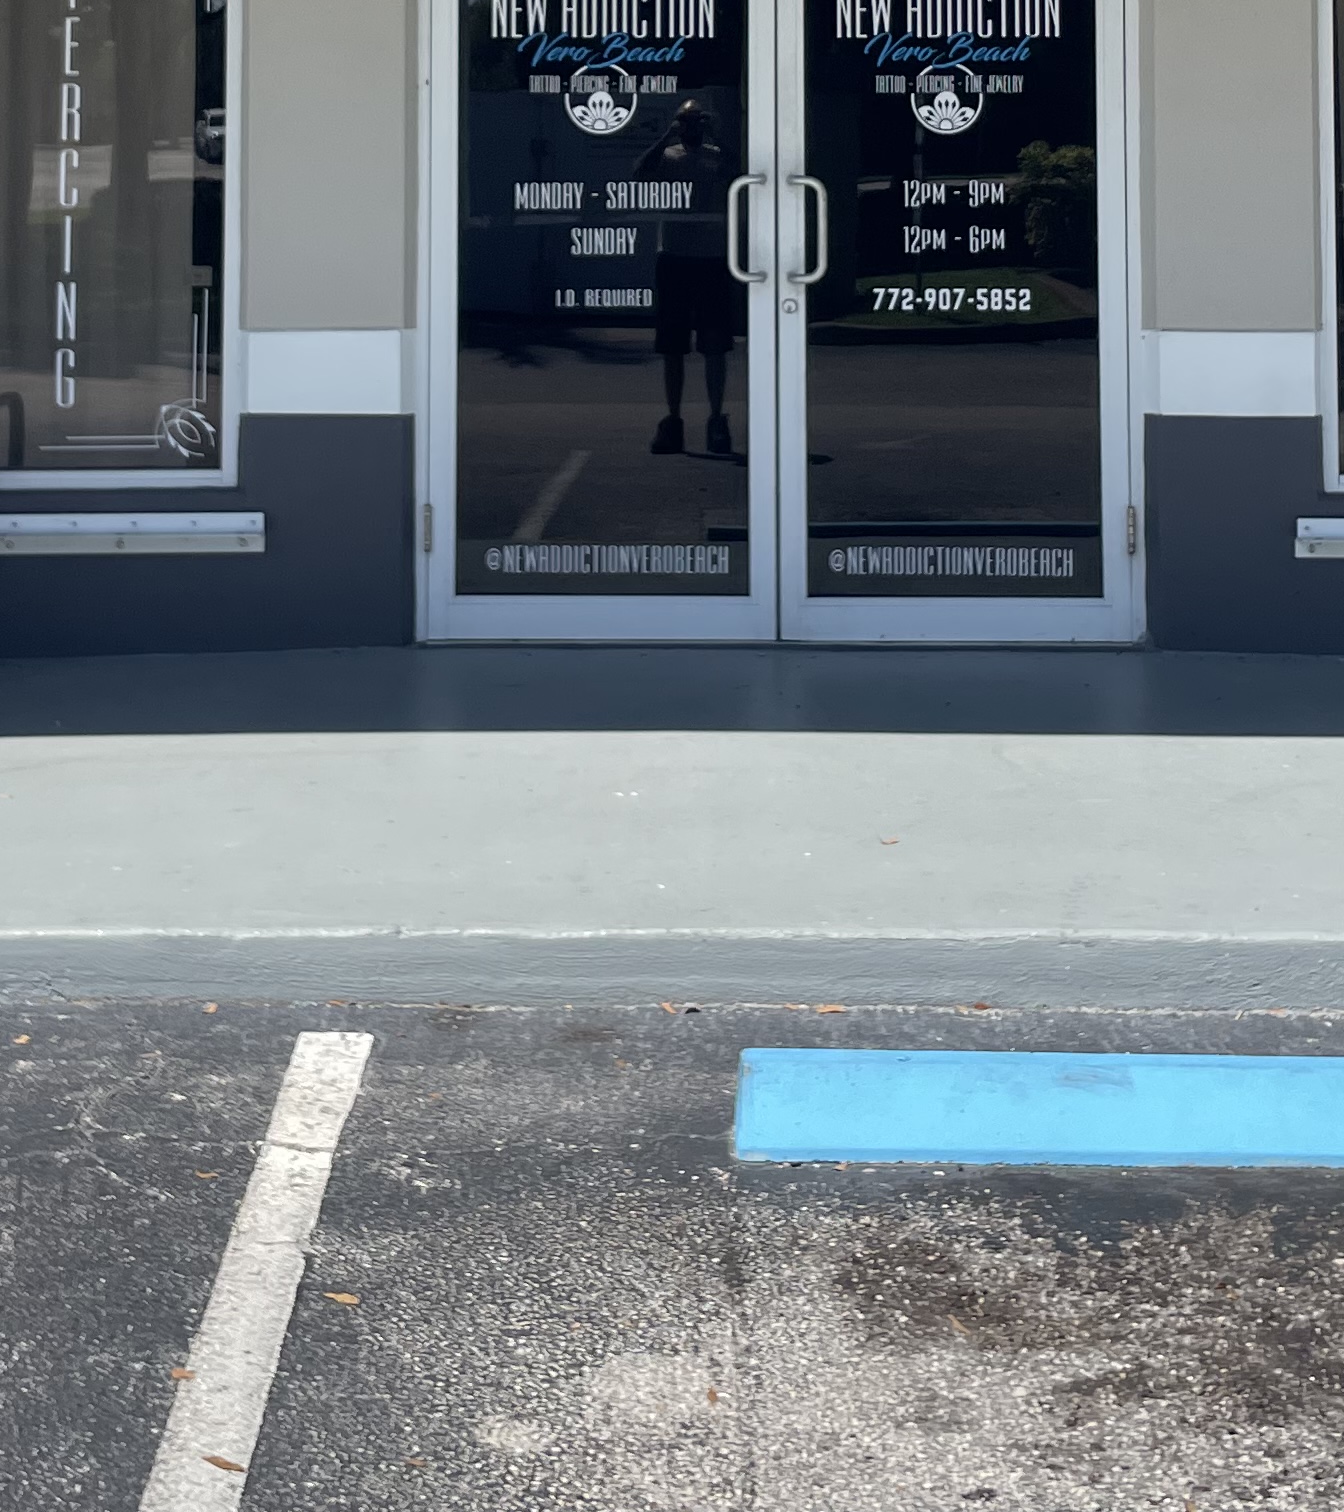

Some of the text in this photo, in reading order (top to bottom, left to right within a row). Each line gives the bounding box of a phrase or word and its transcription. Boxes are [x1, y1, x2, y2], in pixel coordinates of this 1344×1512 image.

[517, 32, 686, 69] Vero Beach
[864, 31, 1032, 68] Vero Beach
[514, 181, 585, 211] MONDAY
[605, 181, 693, 210] SATURDAY
[902, 179, 946, 208] 12PM
[968, 179, 1005, 208] 9PM
[570, 227, 637, 256] SUNDAY
[902, 225, 946, 254] 12PM
[968, 225, 1006, 254] 6PM
[584, 288, 653, 309] REQUIRED
[872, 287, 1032, 312] 772-907-5852
[485, 544, 730, 575] @NEWADDICTIONVEROBEACH
[828, 545, 1075, 578] @NEWADDICTIONVEROBEACH
